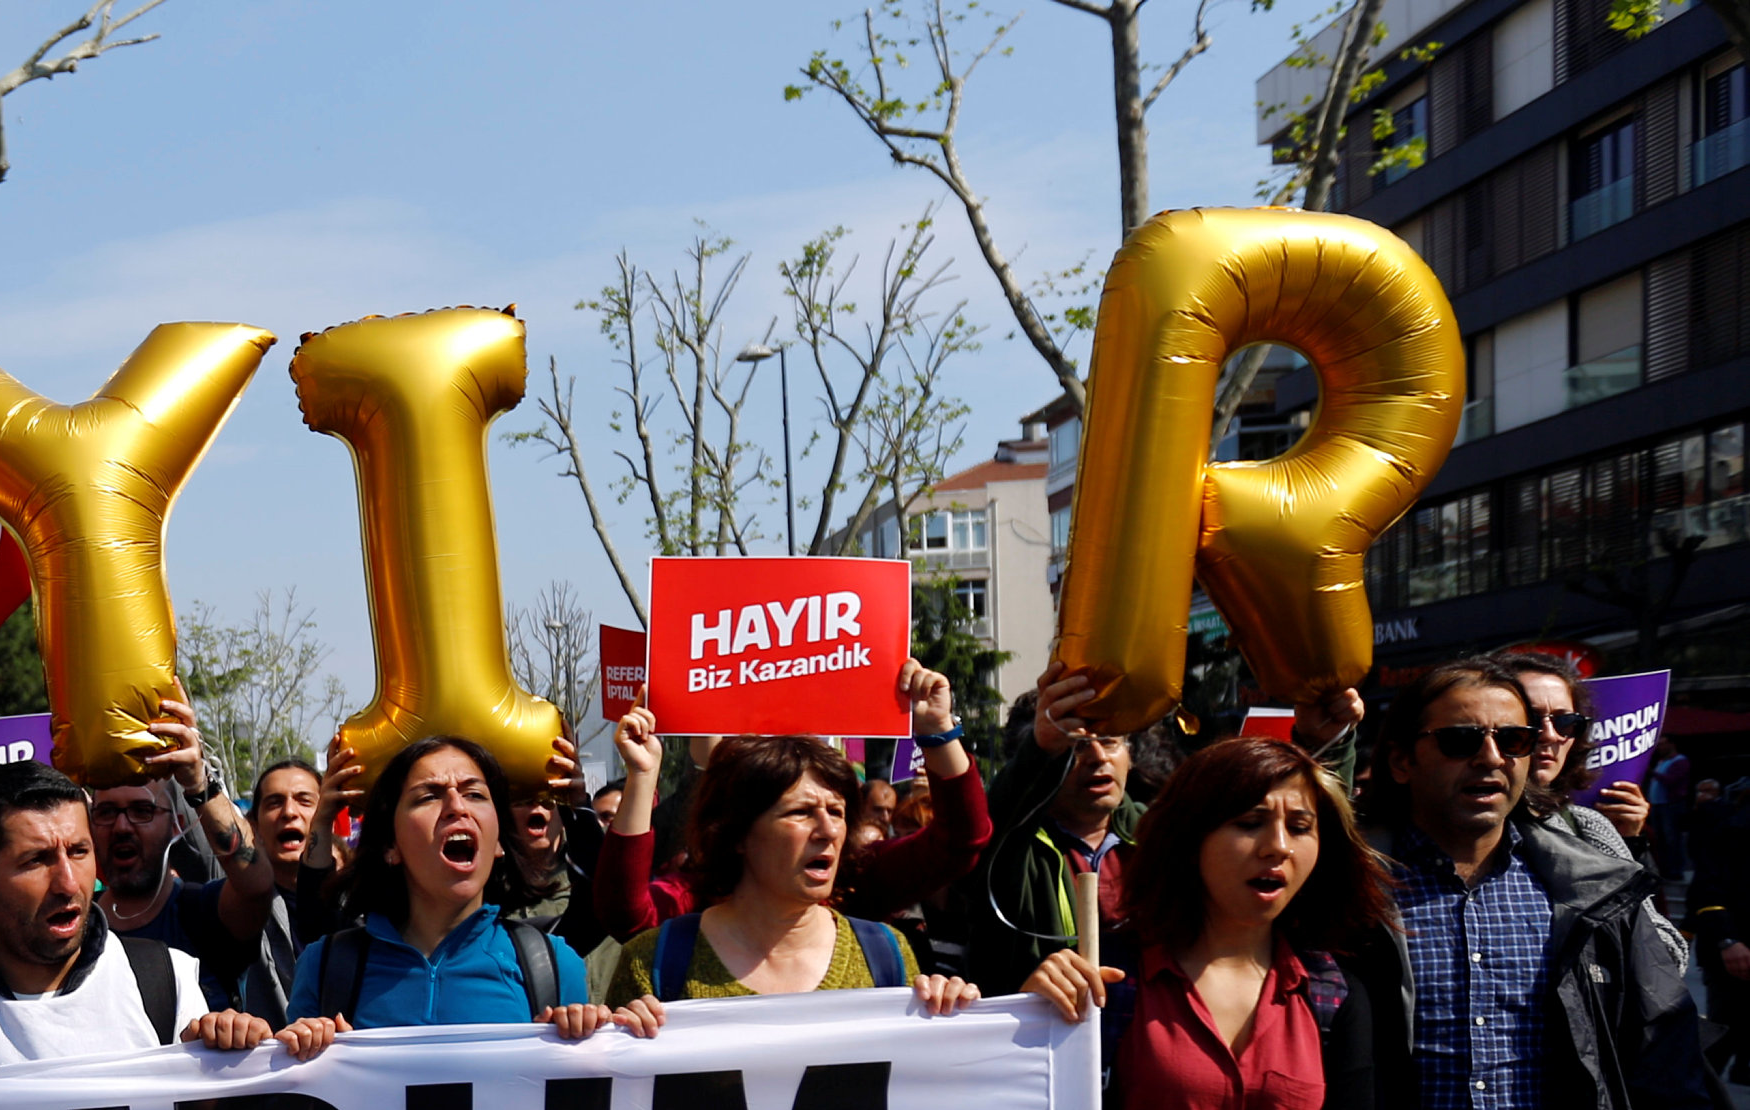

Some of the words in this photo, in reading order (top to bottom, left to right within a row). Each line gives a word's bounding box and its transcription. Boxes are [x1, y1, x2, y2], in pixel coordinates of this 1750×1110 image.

[690, 591, 862, 661] HAYIR
[1374, 617, 1419, 645] BANK
[606, 665, 646, 681] REFER
[688, 665, 732, 693] Biz
[739, 642, 872, 685] Kazandık
[606, 682, 637, 701] İPTAL
[1588, 702, 1660, 743] ANDUM
